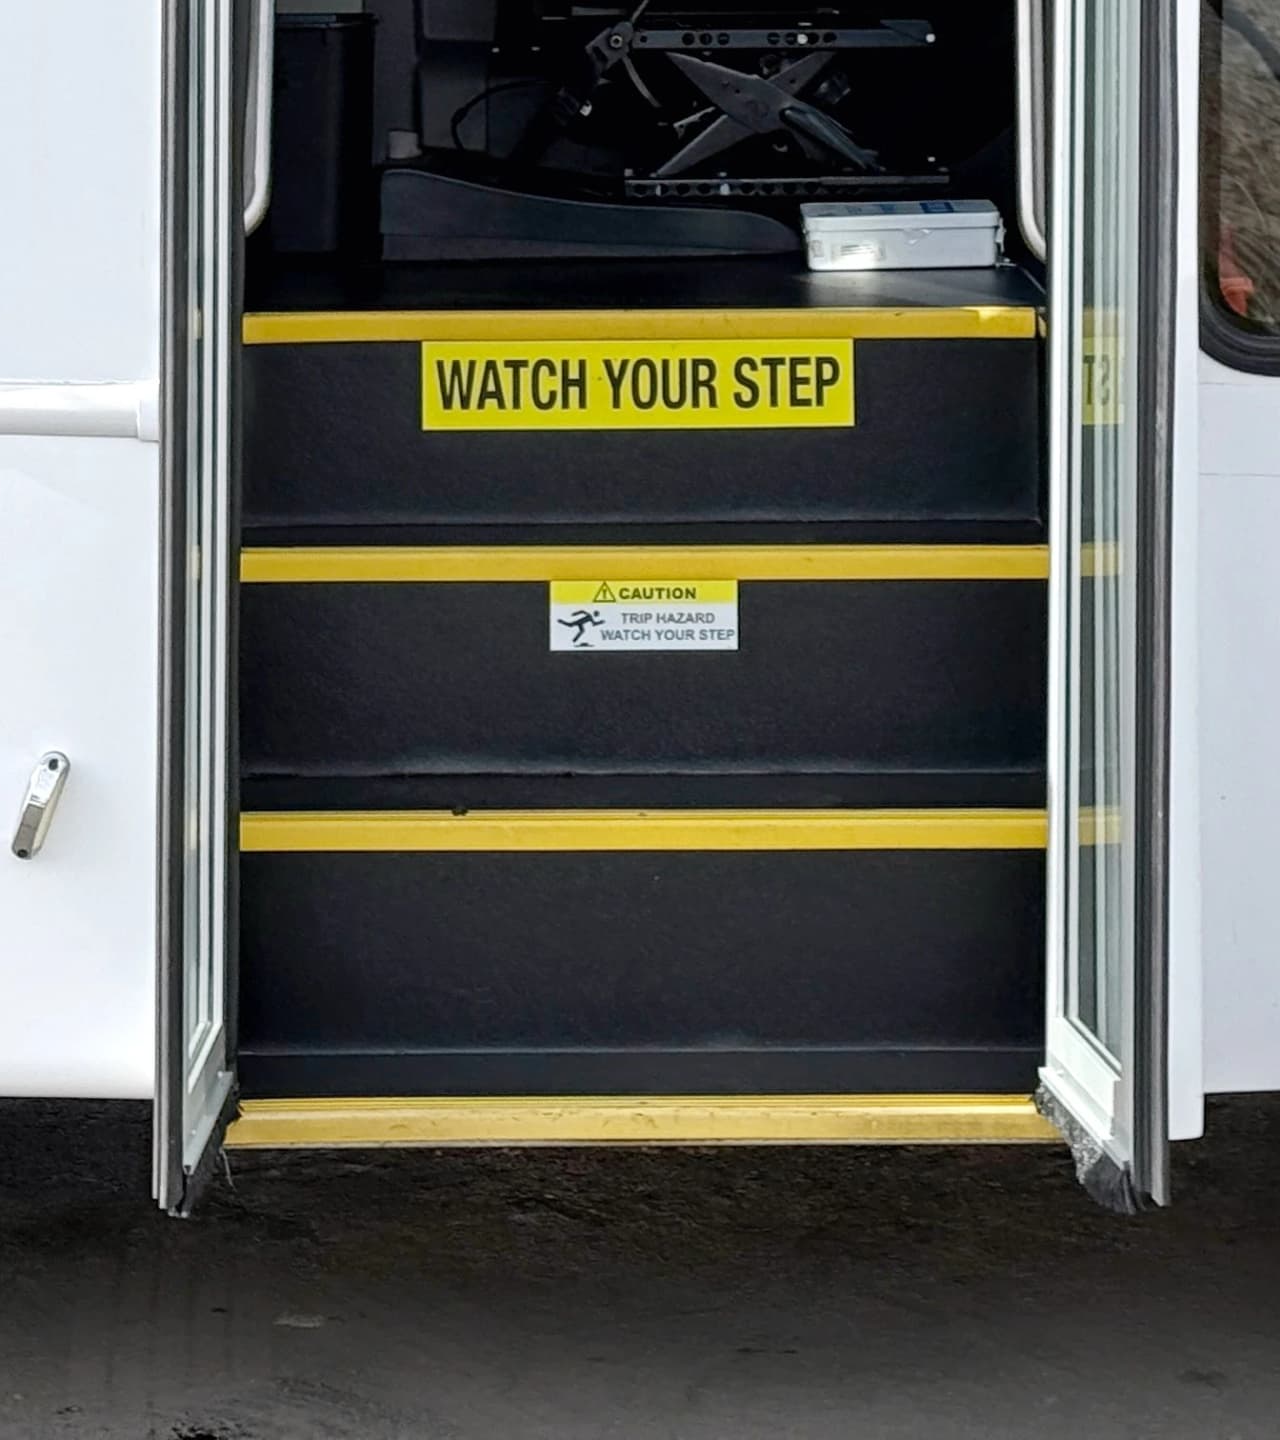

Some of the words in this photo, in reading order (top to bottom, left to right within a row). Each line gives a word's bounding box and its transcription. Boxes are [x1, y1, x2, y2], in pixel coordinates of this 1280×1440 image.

[436, 358, 588, 411] WATCH
[601, 357, 719, 411] YOUR
[732, 355, 841, 410] STEP
[619, 587, 697, 600] CAUTION
[621, 612, 652, 625] TRIP
[656, 612, 716, 625] HAZARD
[600, 628, 651, 641] WATCH
[654, 628, 696, 641] YOUR
[699, 628, 736, 641] STEP
